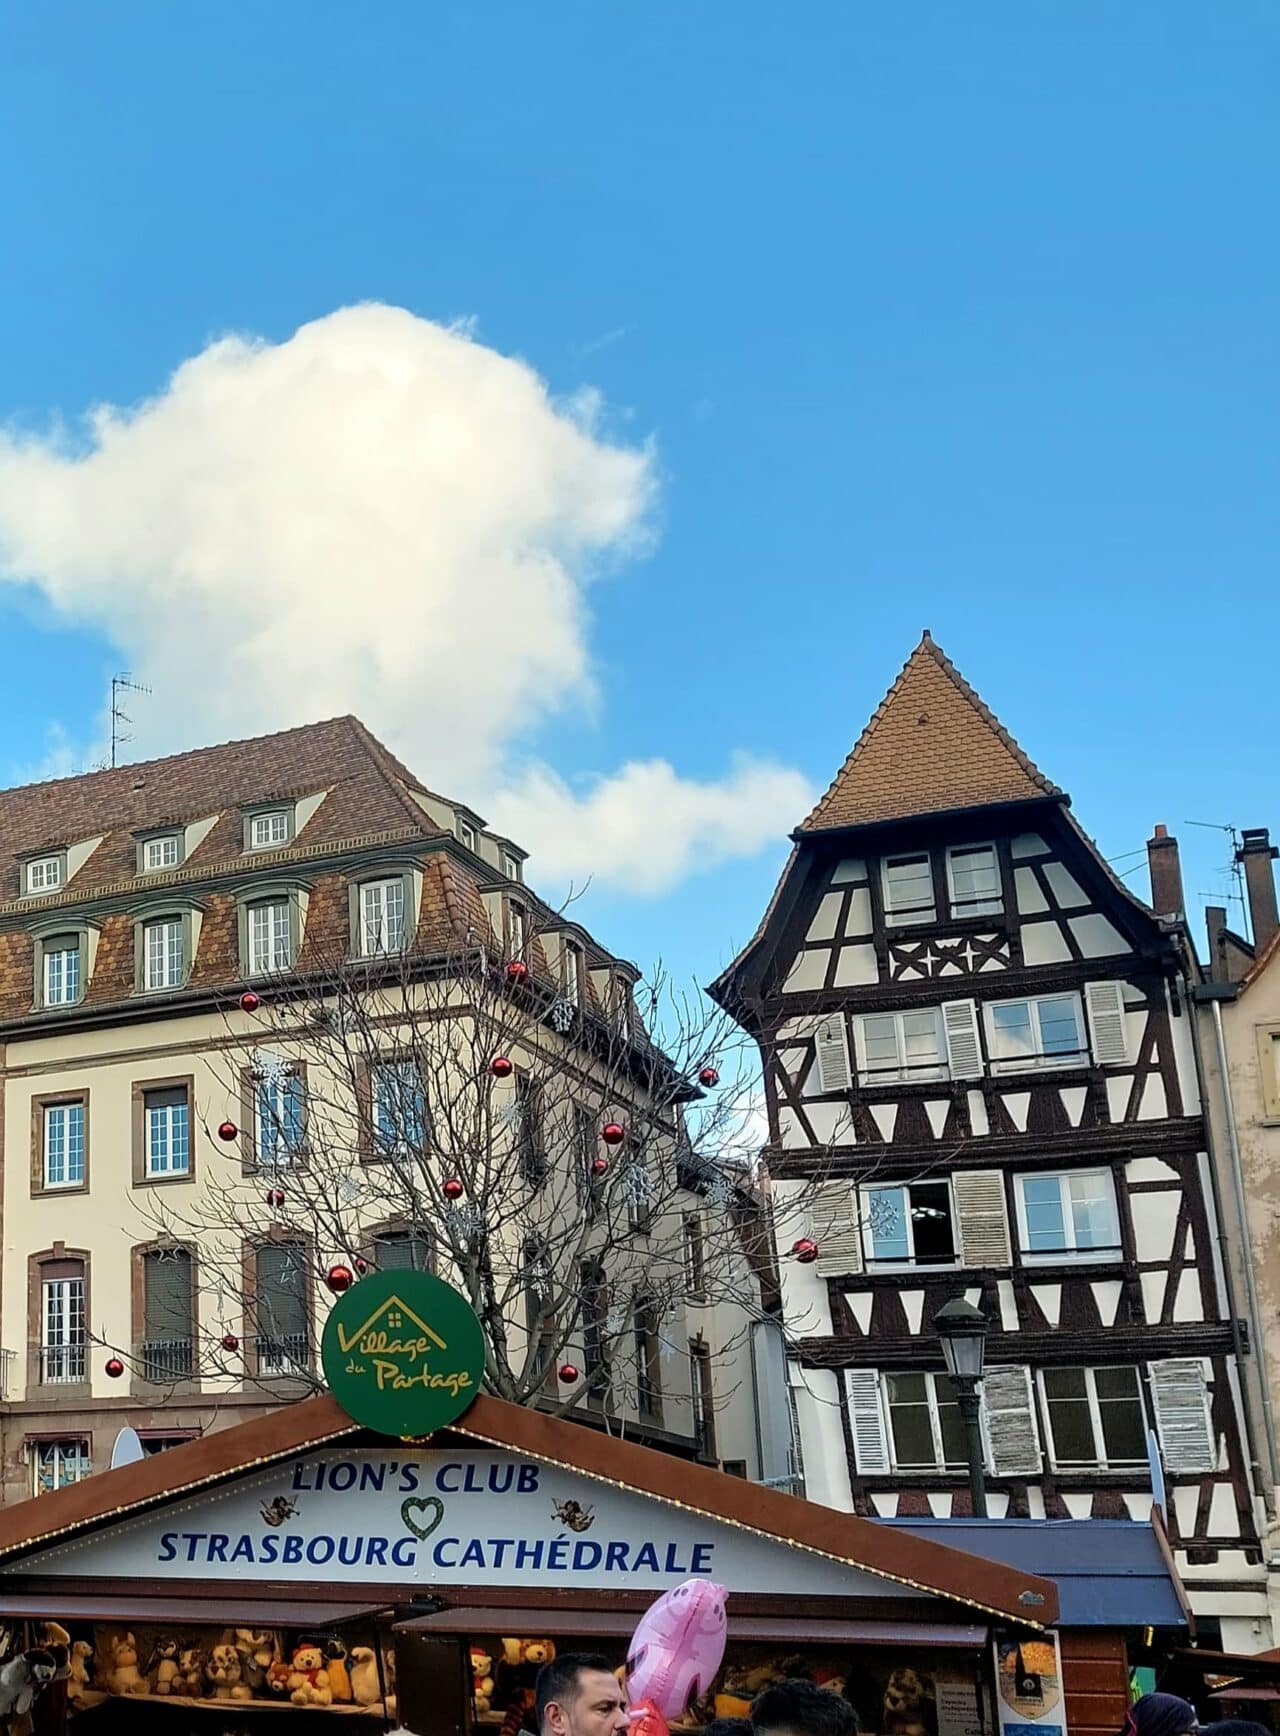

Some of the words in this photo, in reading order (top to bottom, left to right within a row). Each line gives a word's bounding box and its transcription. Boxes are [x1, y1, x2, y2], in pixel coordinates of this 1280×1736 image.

[337, 1322, 431, 1362] Village
[345, 1359, 366, 1373] du
[372, 1359, 473, 1397] Partage
[292, 1462, 419, 1492] LION'S
[435, 1463, 539, 1493] CLUB
[158, 1533, 418, 1567] STRASBOURG
[432, 1533, 715, 1573] CATHÉDRALE
